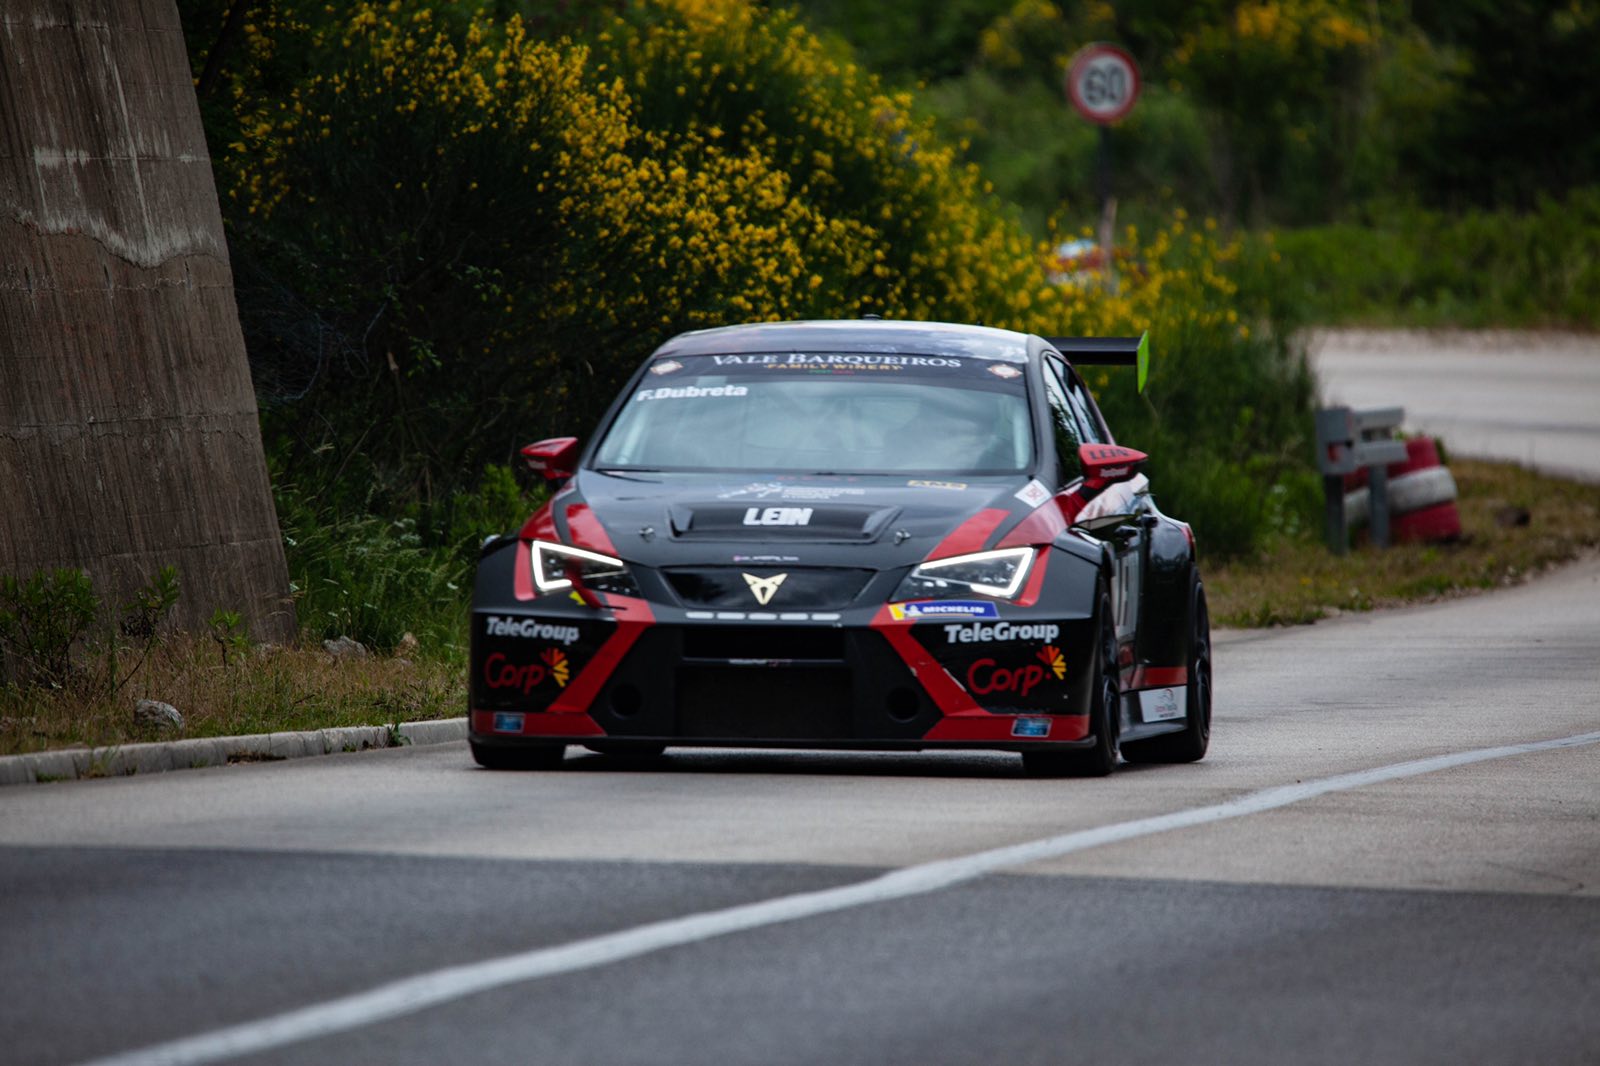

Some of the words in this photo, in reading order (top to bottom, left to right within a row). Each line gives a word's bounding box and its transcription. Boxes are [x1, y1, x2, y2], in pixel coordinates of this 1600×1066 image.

[1084, 63, 1124, 106] 60
[712, 354, 778, 366] VALE
[784, 353, 963, 368] BARQUEIROS
[636, 384, 749, 401] F.Dubreta
[922, 605, 985, 614] MICHELIN
[486, 616, 580, 645] TeleGroup
[944, 621, 1060, 644] TeleGroup
[484, 652, 546, 696] Corp
[967, 657, 1044, 697] Corp
